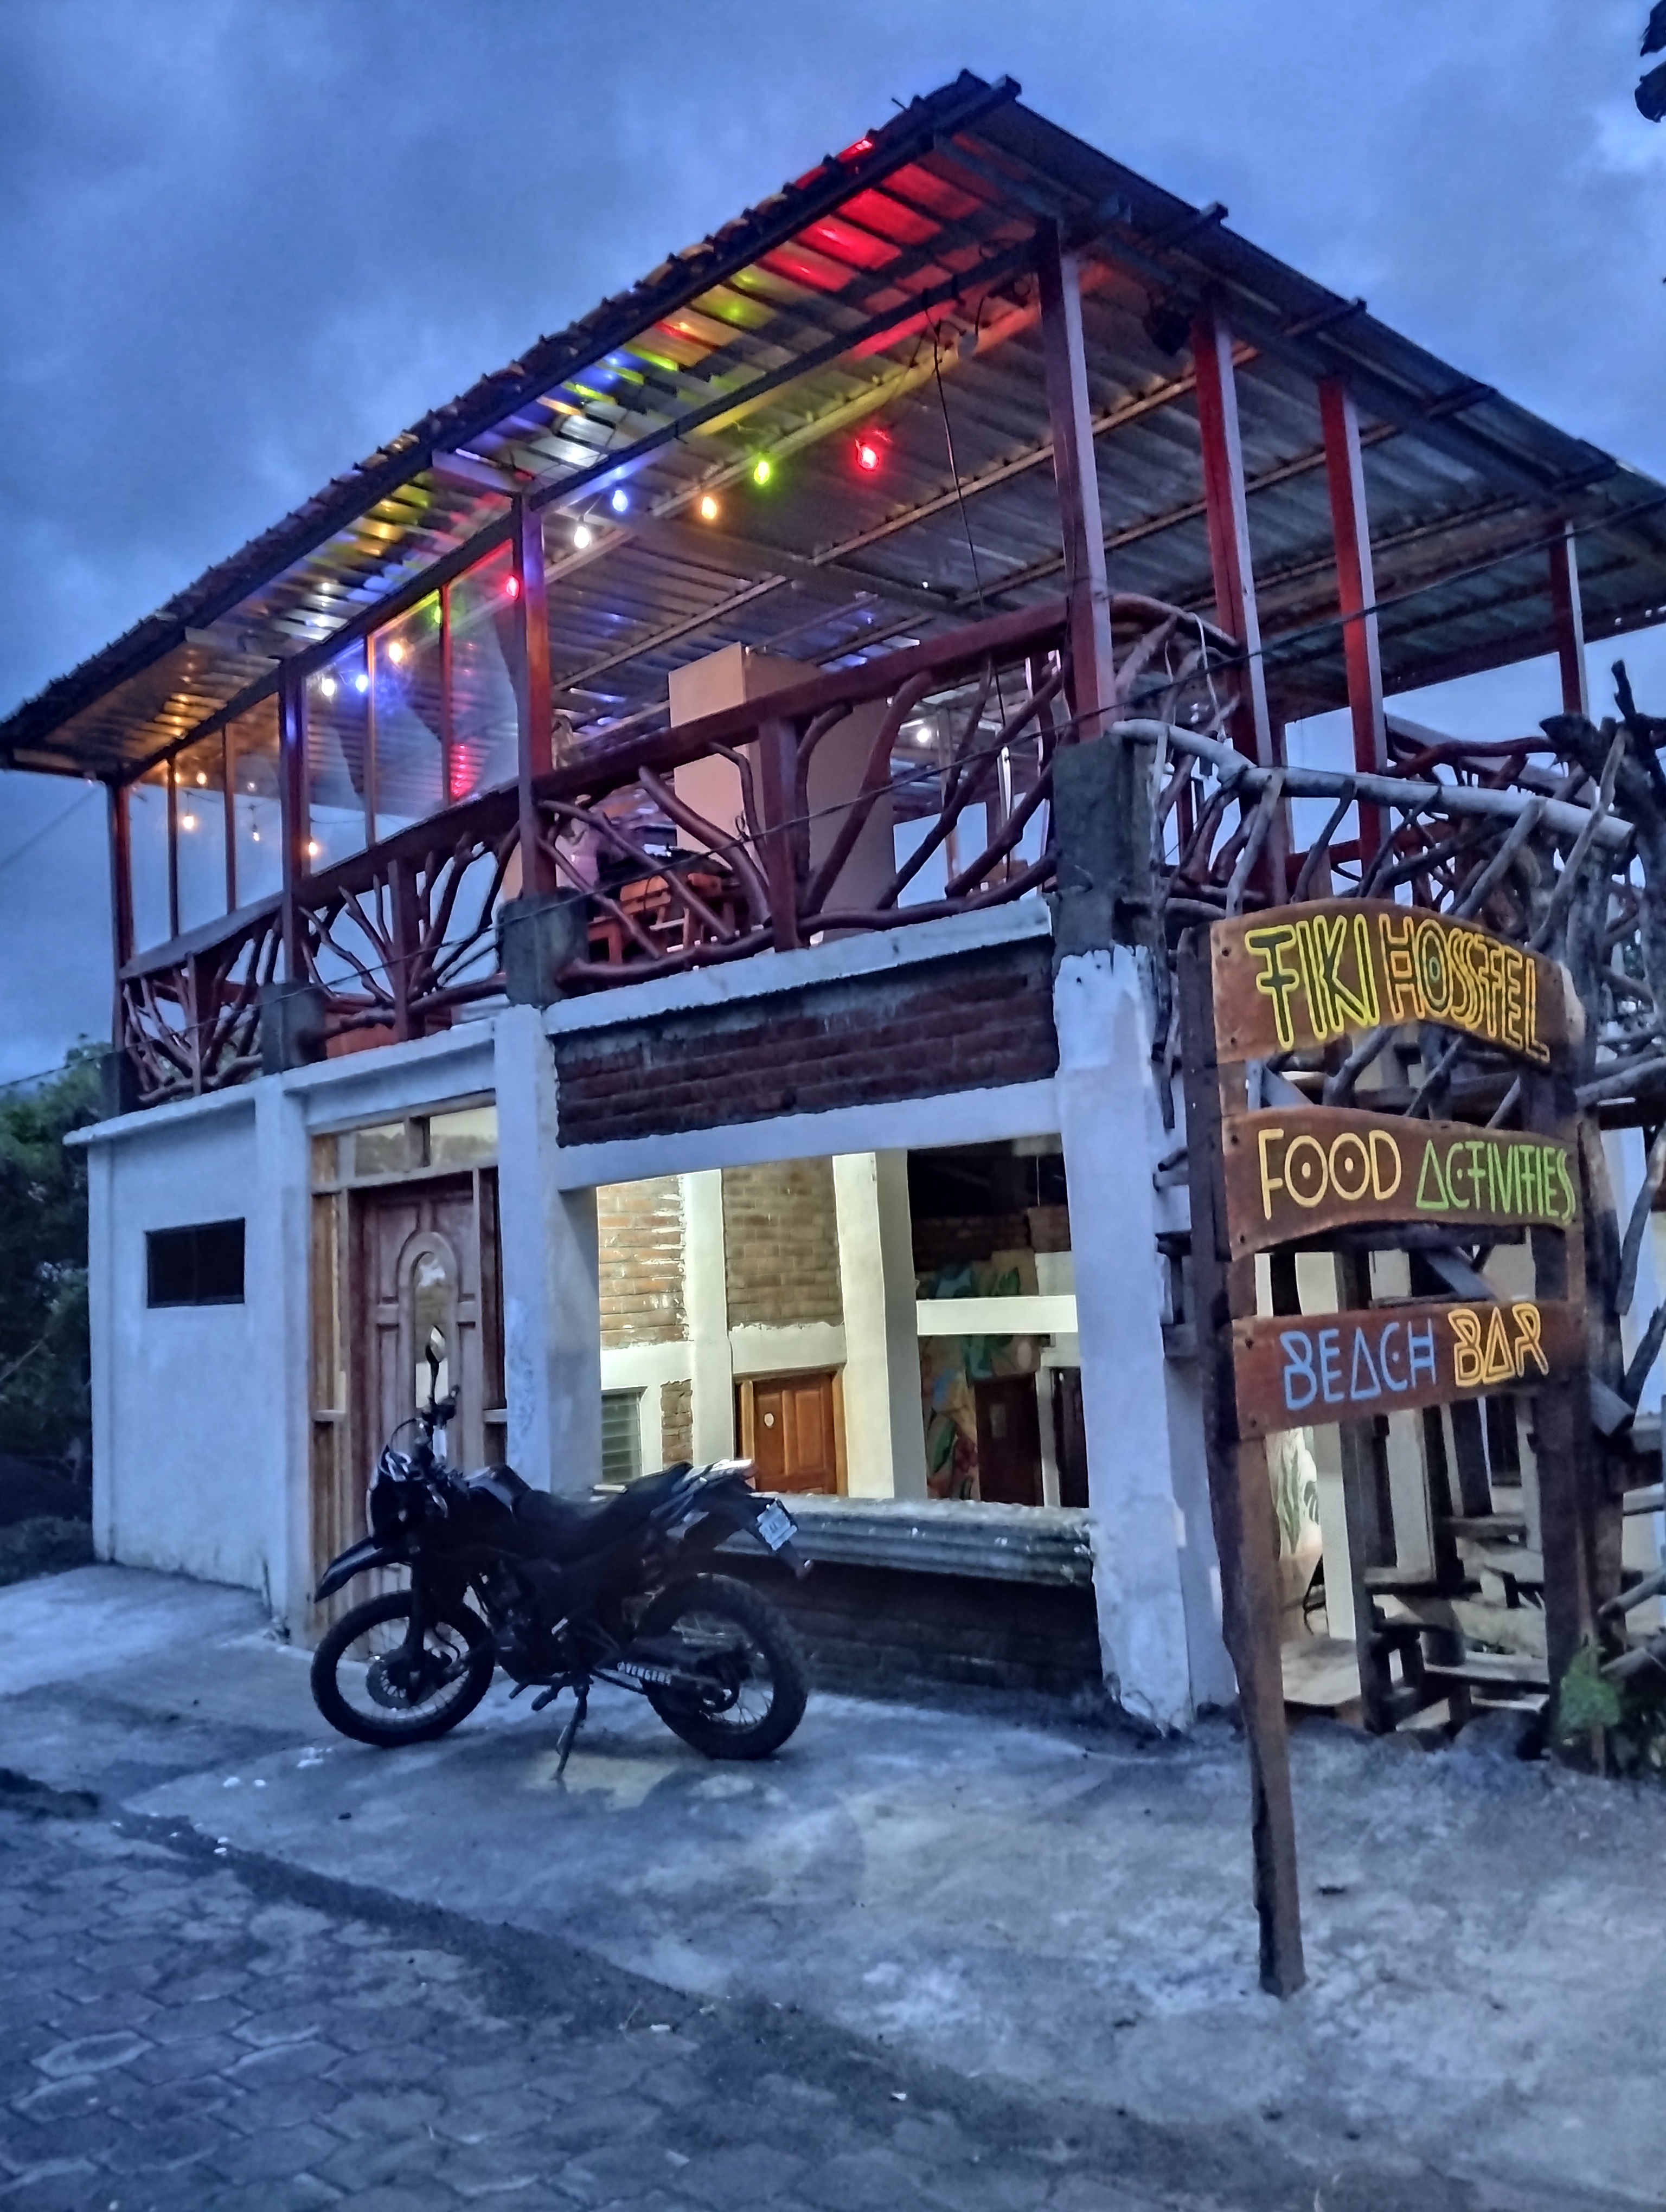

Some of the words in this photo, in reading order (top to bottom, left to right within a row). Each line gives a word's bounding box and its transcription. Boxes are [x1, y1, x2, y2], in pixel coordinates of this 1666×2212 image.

[1245, 914, 1380, 1050] TIKI
[1258, 1128, 1401, 1219] FOOD
[1416, 1140, 1576, 1221] ACTIVITIES
[1280, 1318, 1436, 1410] BEACH
[1448, 1303, 1549, 1387] BAR
